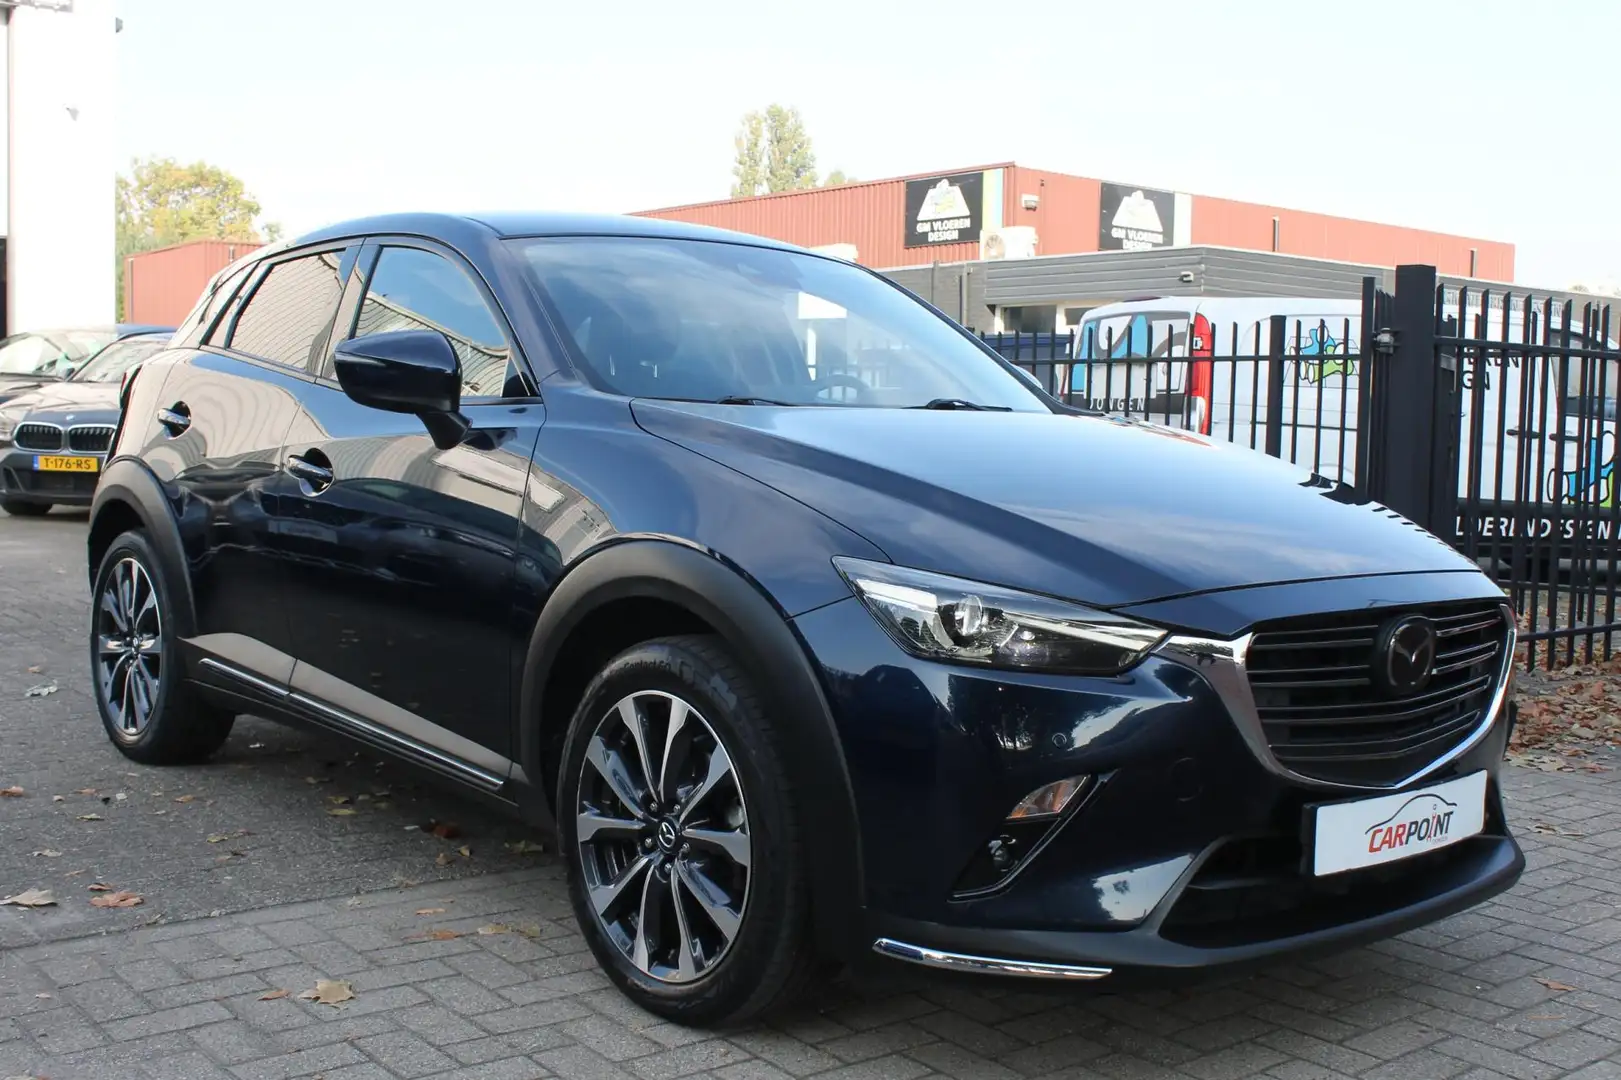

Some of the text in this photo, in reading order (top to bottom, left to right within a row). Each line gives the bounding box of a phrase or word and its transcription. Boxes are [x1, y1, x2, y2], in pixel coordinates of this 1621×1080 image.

[916, 217, 971, 233] GM VLOEREN
[928, 229, 959, 242] DESIGN
[1111, 227, 1126, 239] GM
[44, 457, 91, 470] T-176-RS
[1368, 810, 1454, 853] CARPOINT
